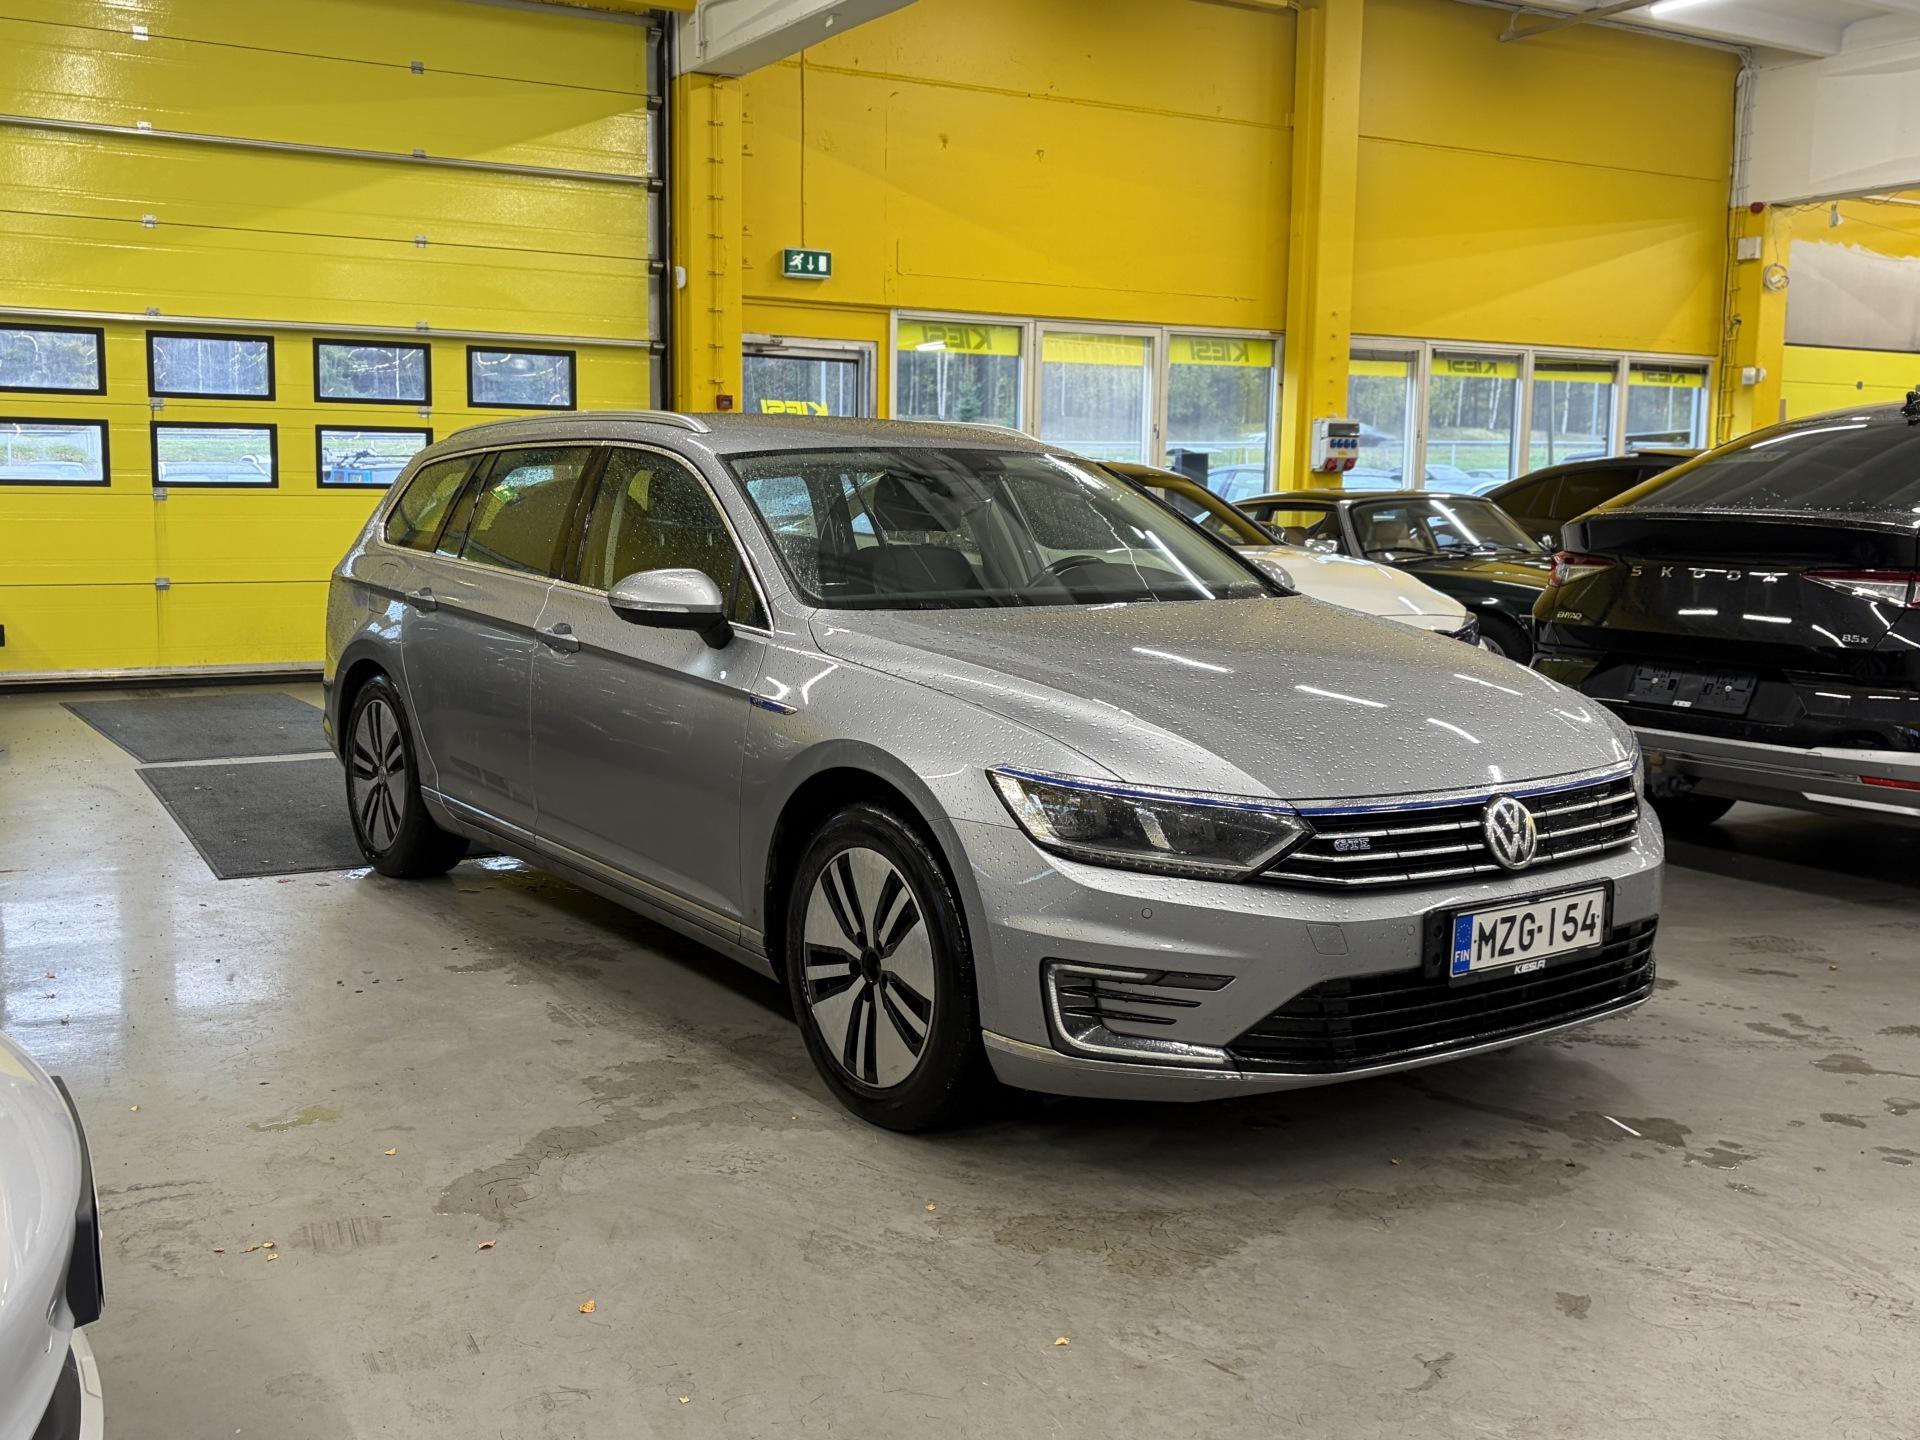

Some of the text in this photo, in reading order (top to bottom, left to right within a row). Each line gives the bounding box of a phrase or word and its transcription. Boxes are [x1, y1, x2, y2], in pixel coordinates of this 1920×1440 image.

[1334, 838, 1371, 851] GTE
[1476, 900, 1597, 961] MZG-154
[1454, 948, 1471, 963] FIN
